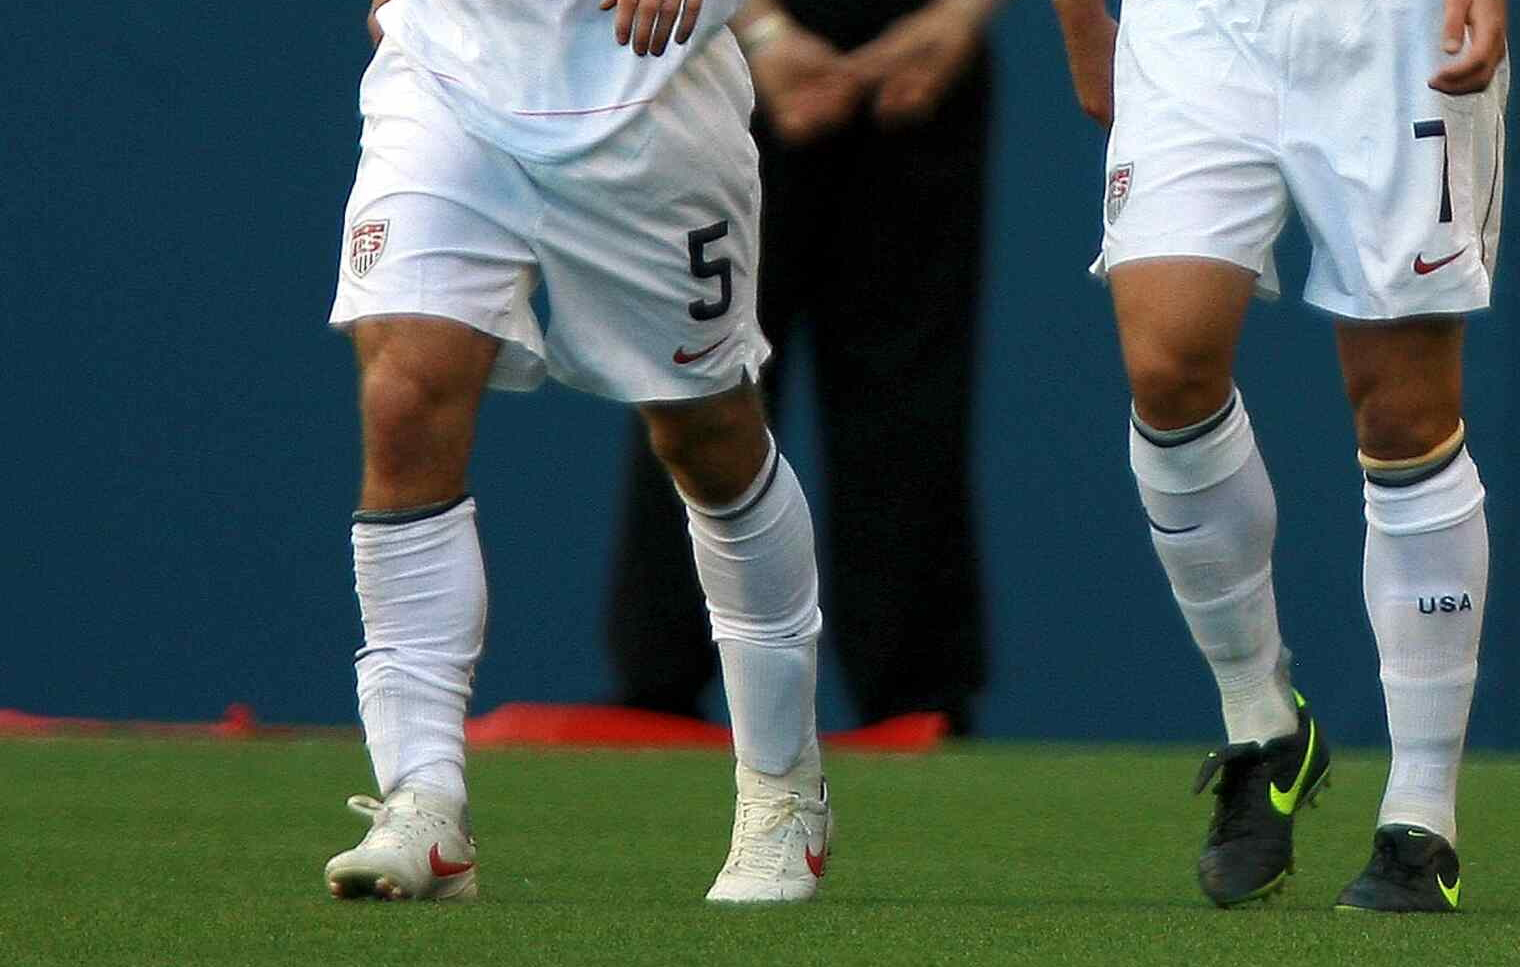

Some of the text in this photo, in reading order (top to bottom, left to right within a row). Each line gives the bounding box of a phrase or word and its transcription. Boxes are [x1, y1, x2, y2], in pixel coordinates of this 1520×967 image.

[1412, 118, 1451, 223] 7
[687, 219, 732, 323] 5
[1418, 593, 1472, 615] USA
